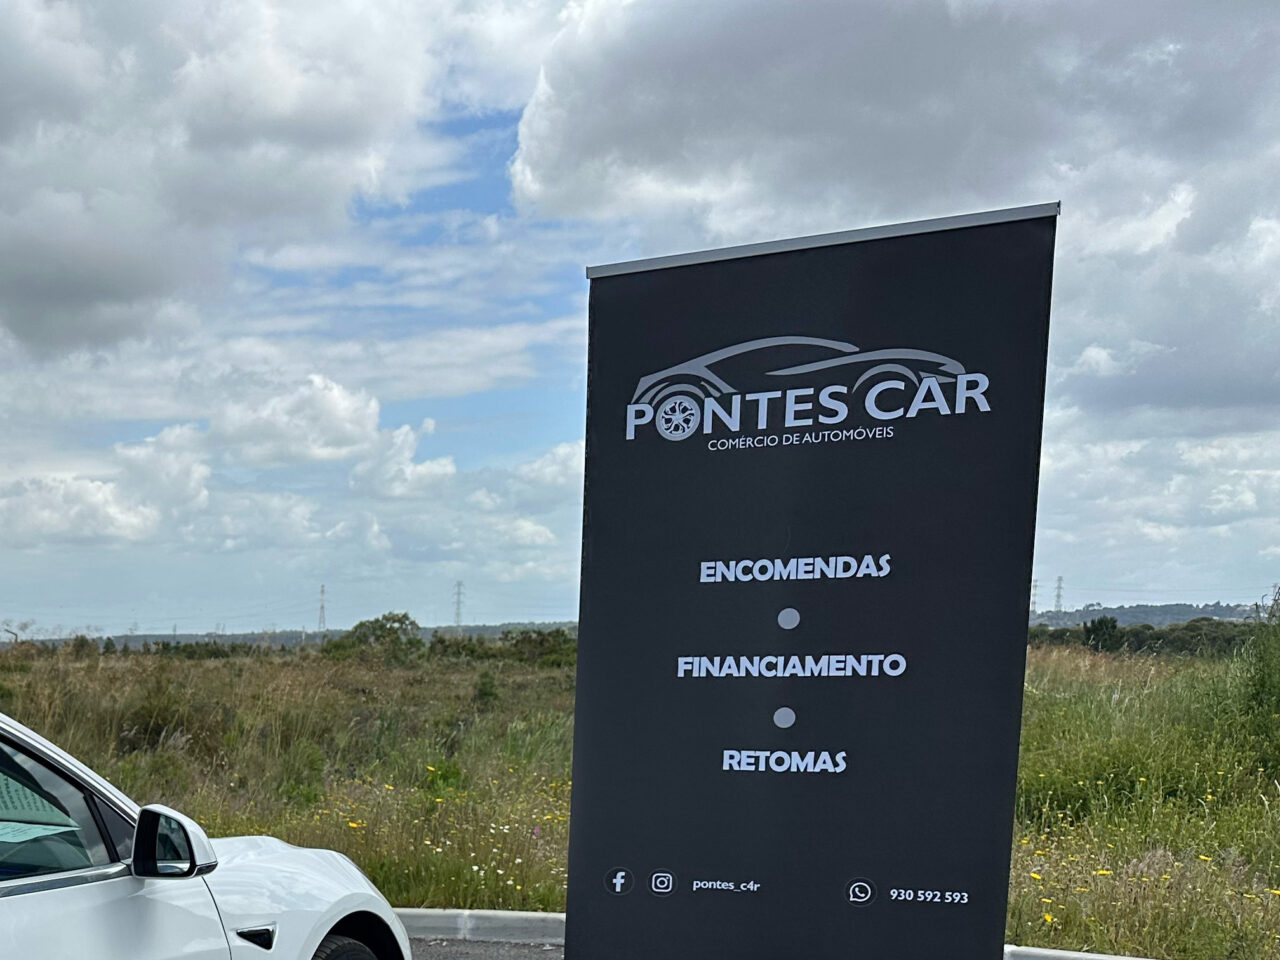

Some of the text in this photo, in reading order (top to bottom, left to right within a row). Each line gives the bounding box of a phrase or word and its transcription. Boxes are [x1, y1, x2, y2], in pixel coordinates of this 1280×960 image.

[625, 372, 992, 442] PONTES CAR
[707, 425, 895, 451] COMÉRCIO DE AUTOMÓVEIS
[699, 553, 891, 583] ENCOMENDAS
[677, 653, 907, 678] FINANCIAMENTO
[722, 749, 847, 774] RETOMAS
[692, 880, 761, 892] pontes_c4r
[889, 888, 969, 904] 930 592 593
